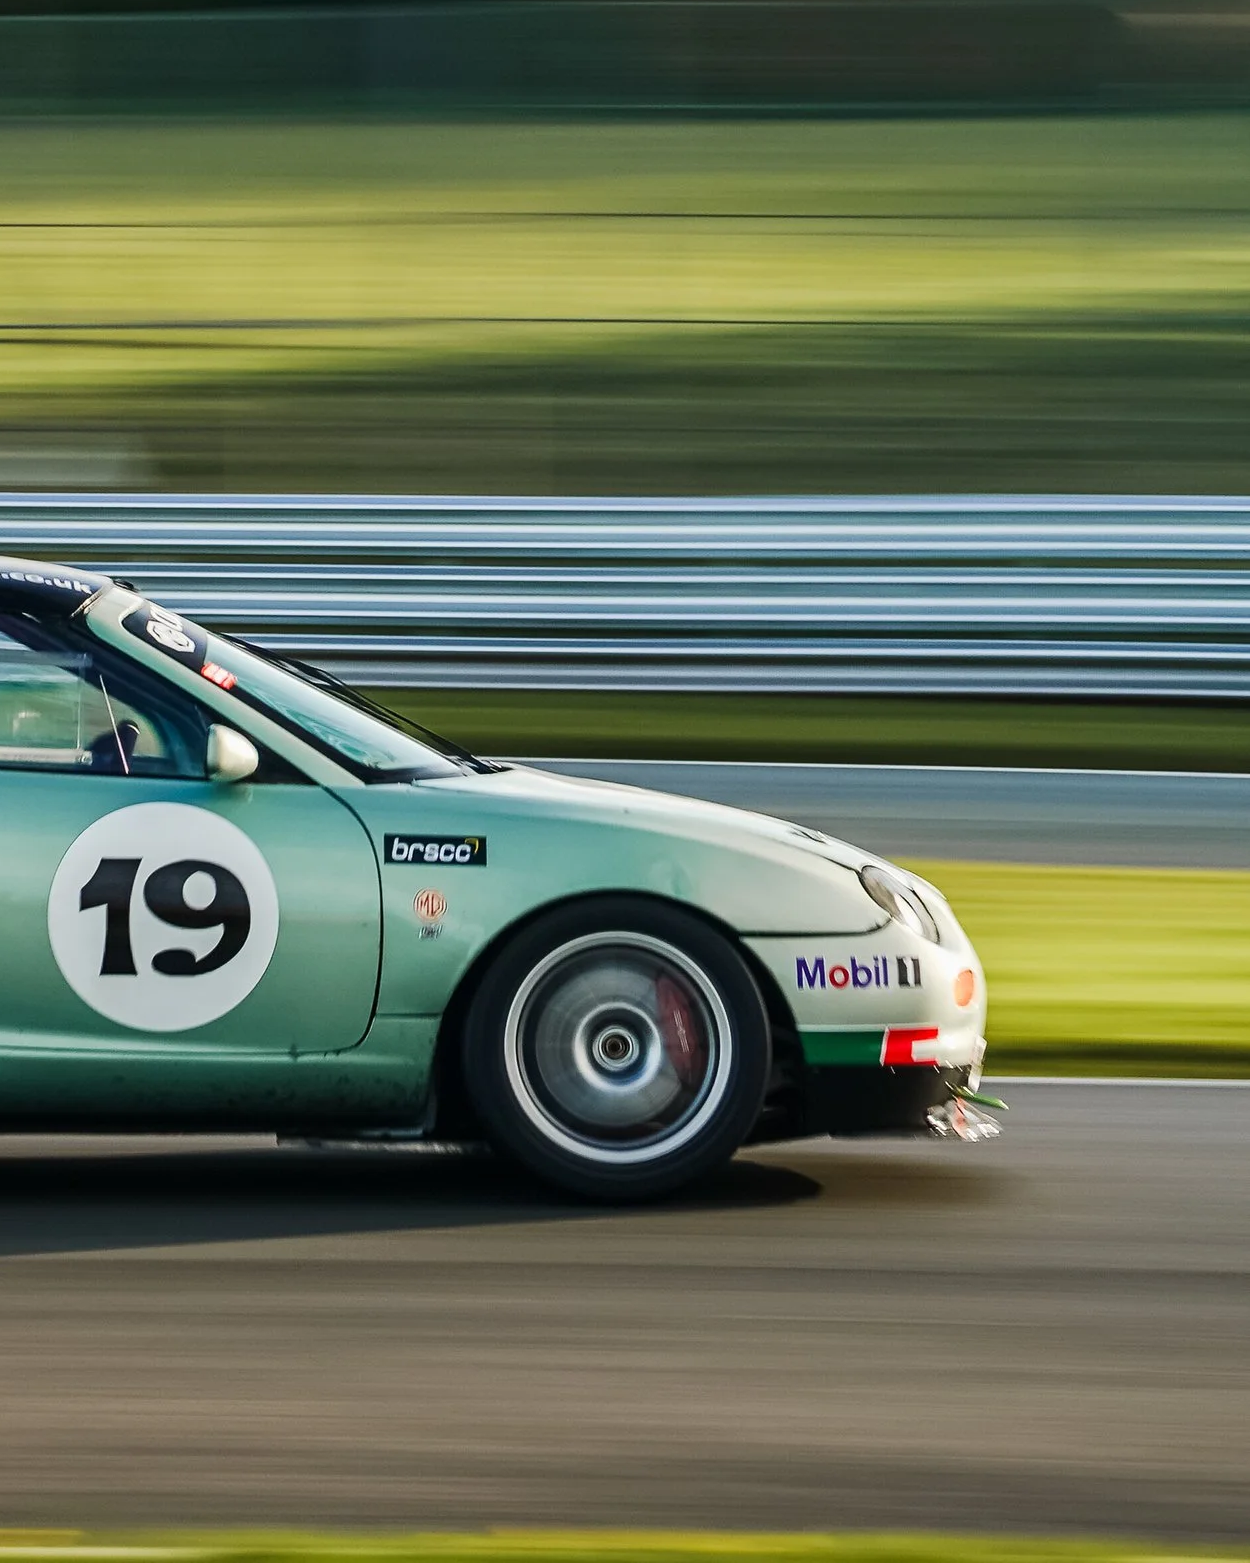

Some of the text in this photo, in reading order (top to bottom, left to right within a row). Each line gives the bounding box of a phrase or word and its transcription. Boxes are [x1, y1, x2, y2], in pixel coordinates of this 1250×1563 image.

[392, 837, 471, 863] brscc
[79, 857, 251, 977] 19
[796, 956, 922, 988] Mobil 1
